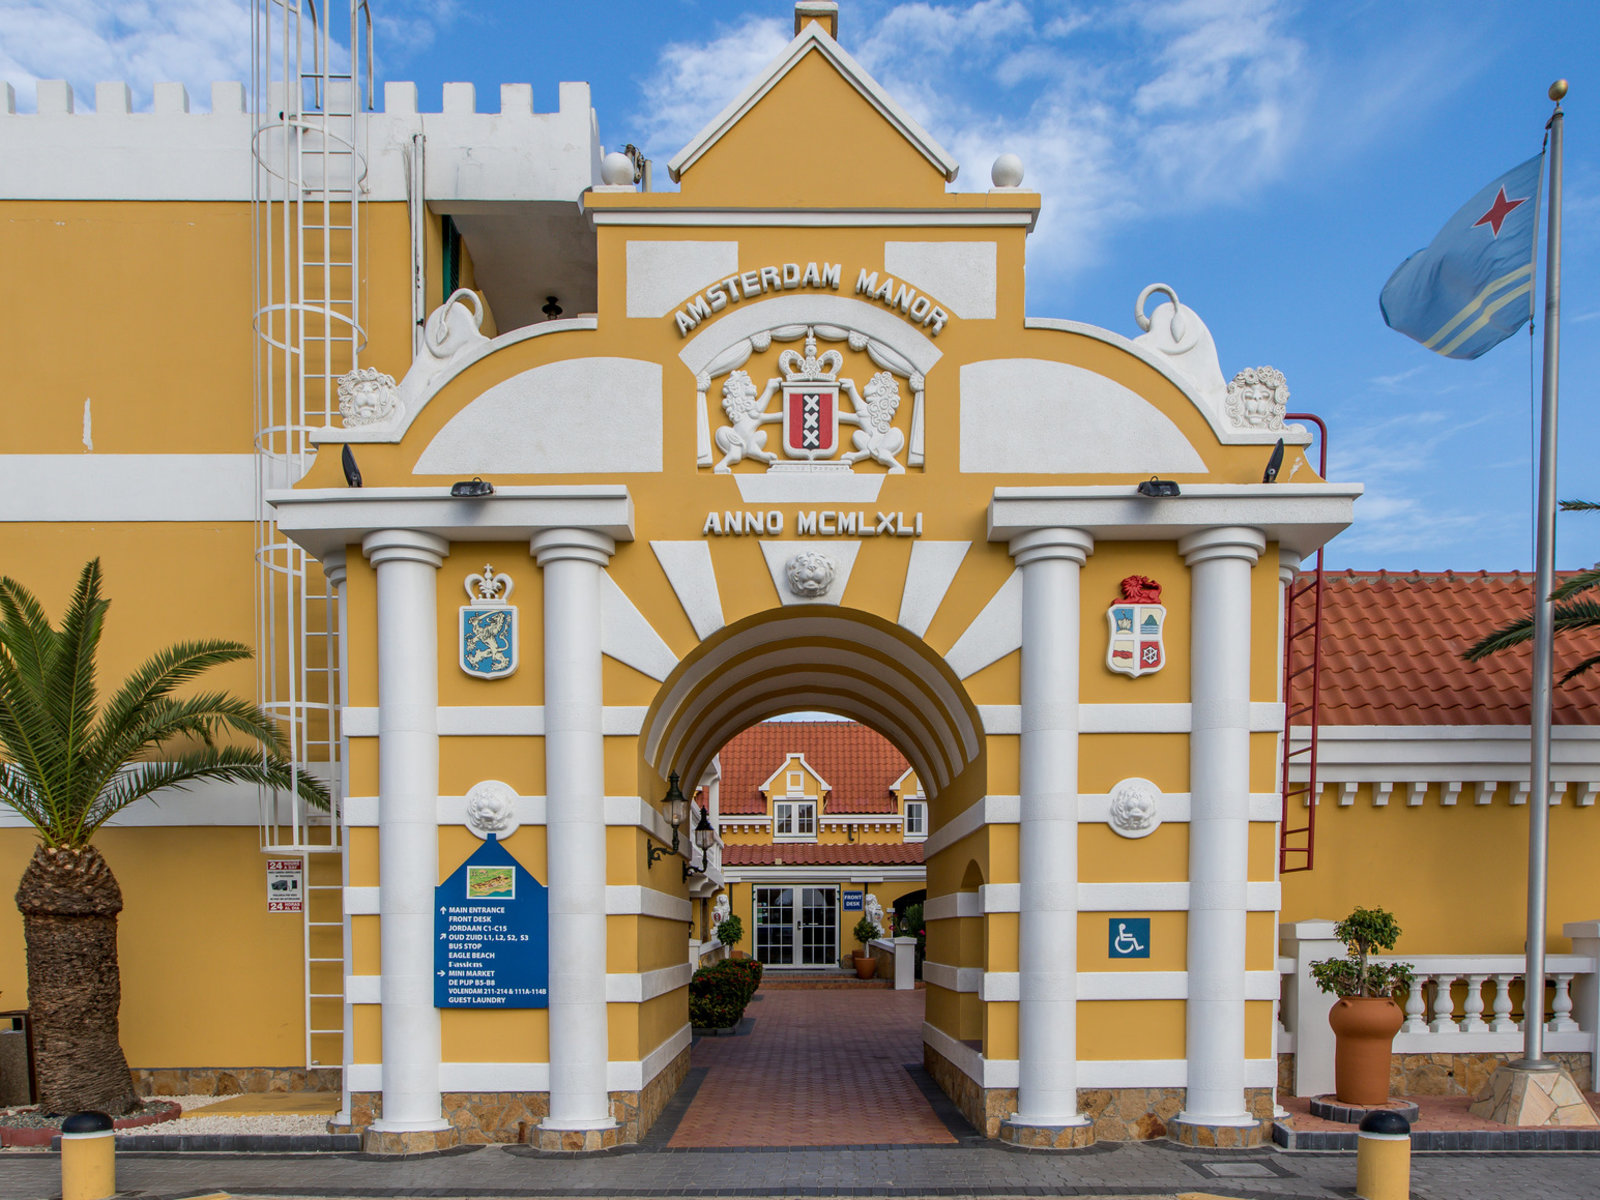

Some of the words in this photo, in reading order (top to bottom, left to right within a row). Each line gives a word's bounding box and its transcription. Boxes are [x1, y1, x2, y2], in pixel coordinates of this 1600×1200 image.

[674, 262, 842, 337] AMSTERDAM
[855, 268, 949, 336] MANOR
[703, 510, 784, 536] ANNO
[797, 510, 923, 536] MCMLXLI
[270, 862, 282, 870] 24
